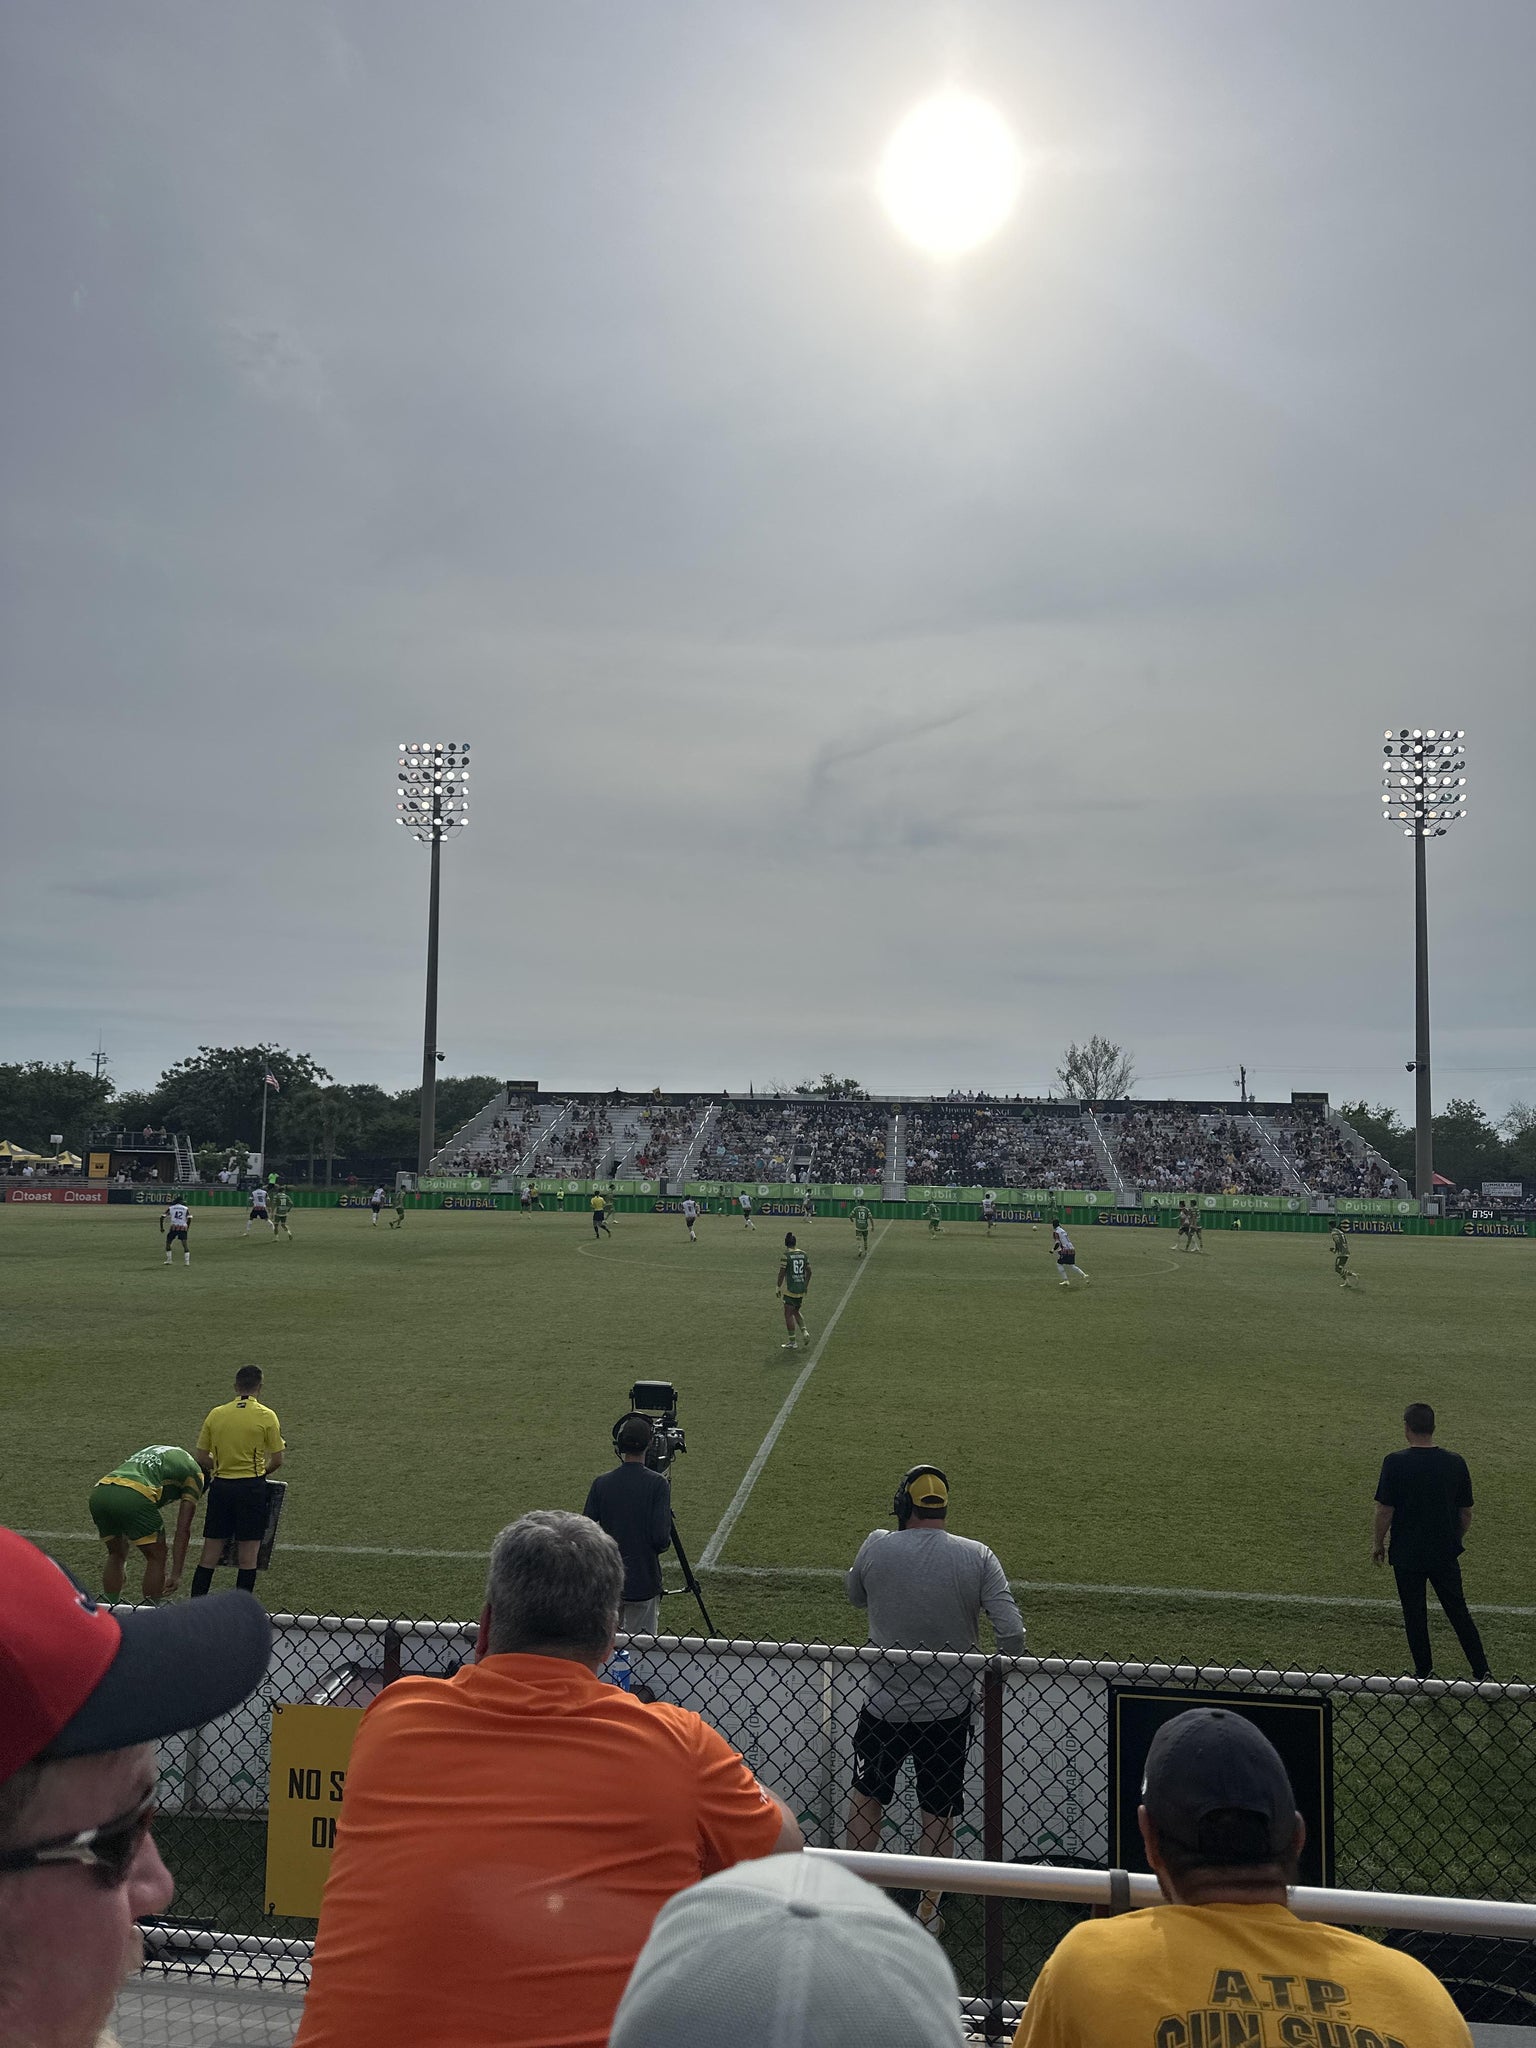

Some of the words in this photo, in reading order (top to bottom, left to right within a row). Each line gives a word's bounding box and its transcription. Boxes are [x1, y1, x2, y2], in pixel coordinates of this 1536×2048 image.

[426, 1180, 457, 1189] Publix
[24, 1192, 52, 1201] toast
[75, 1192, 102, 1202] toast
[1232, 1199, 1268, 1208] Publix
[1345, 1202, 1382, 1212] Publix
[174, 1211, 183, 1220] 42
[858, 1211, 865, 1220] 13
[1472, 1210, 1494, 1219] 87:54
[793, 1260, 804, 1274] 62
[288, 1767, 322, 1801] NO
[1208, 1967, 1352, 2020] A.T.P.
